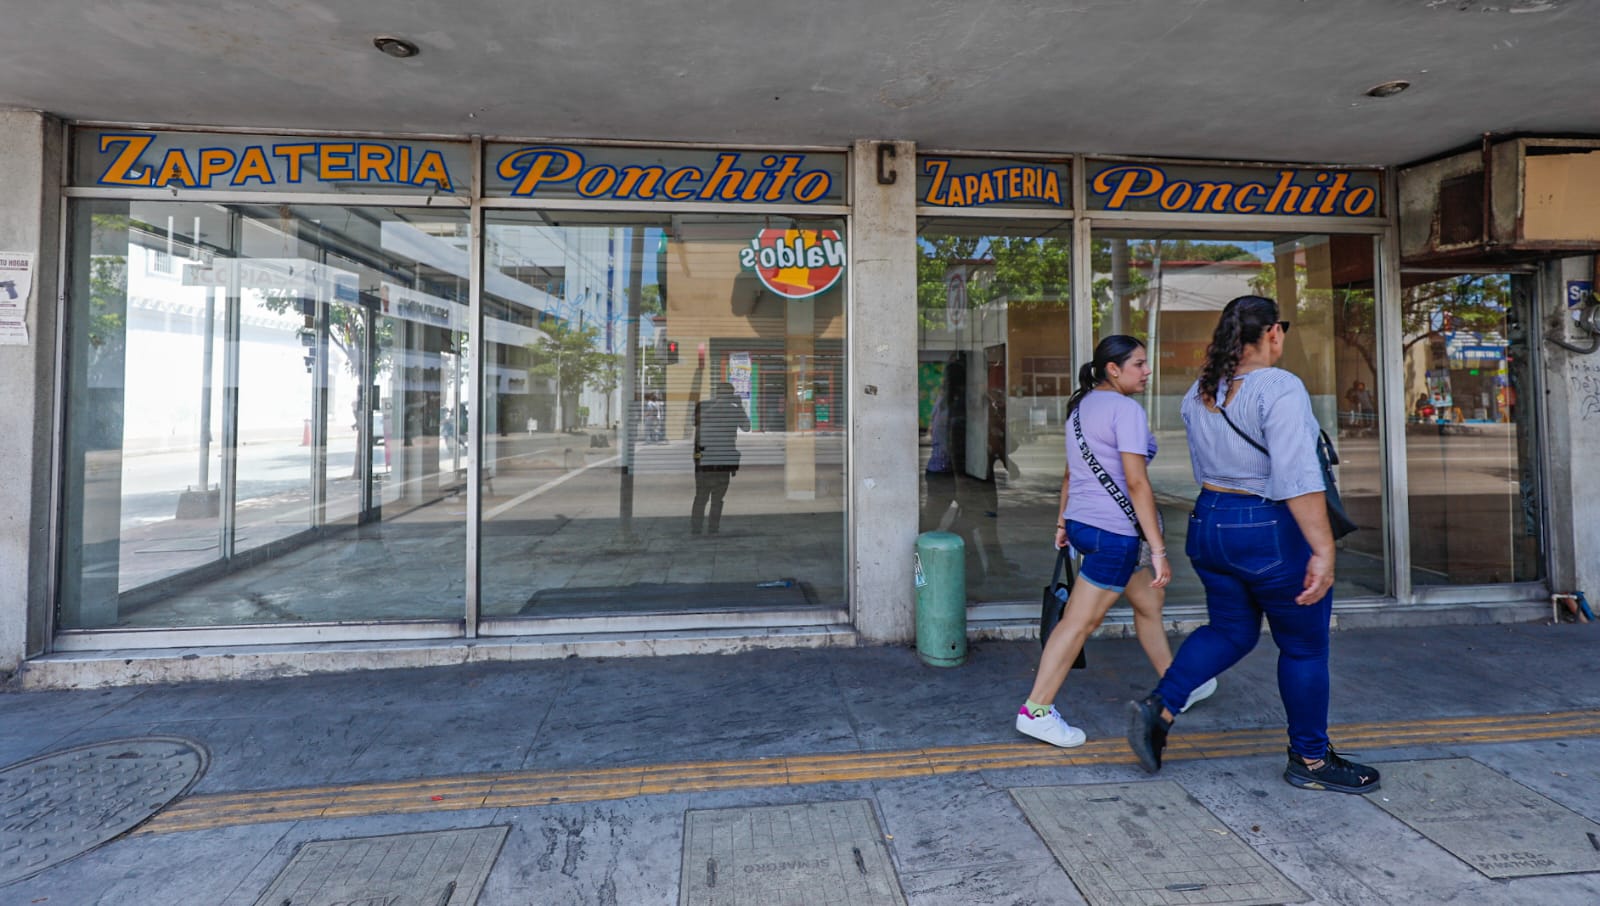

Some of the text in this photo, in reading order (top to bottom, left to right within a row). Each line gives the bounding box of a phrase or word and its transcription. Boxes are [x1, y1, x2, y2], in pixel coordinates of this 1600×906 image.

[97, 133, 832, 203] ZAPATERIA Ponchito
[876, 143, 897, 185] C
[922, 158, 1376, 218] ZAPATERIA Ponchito
